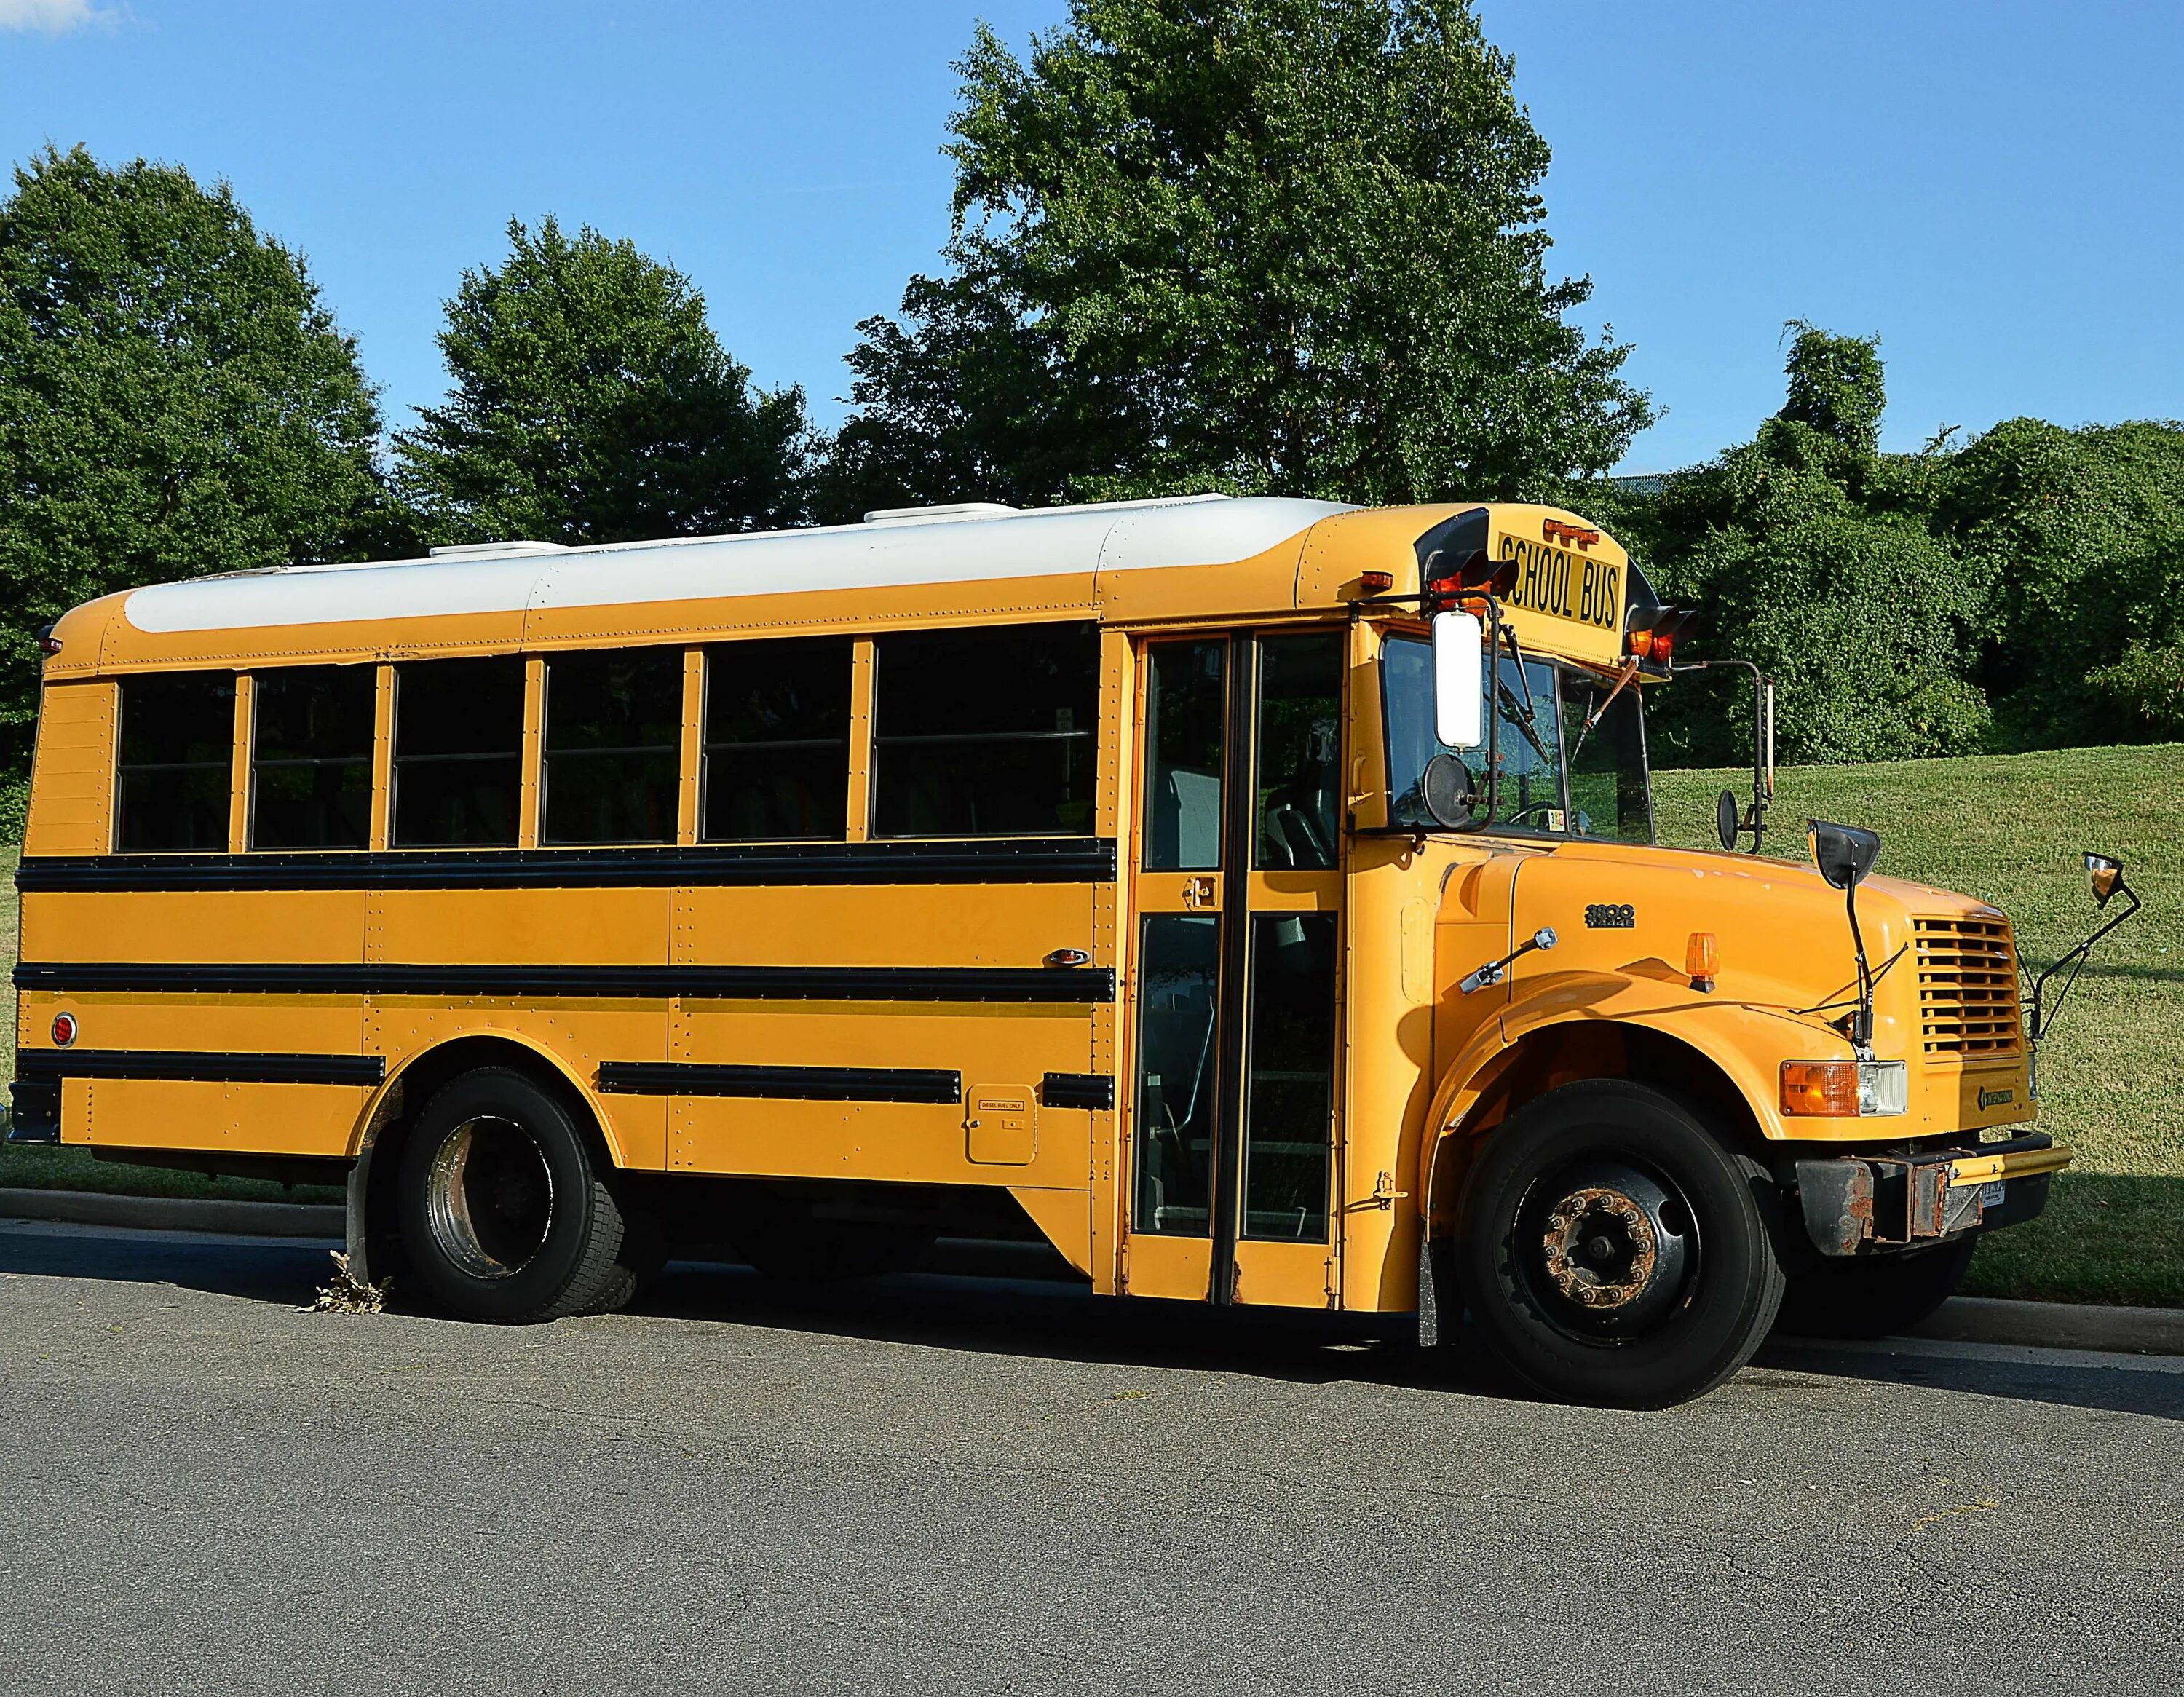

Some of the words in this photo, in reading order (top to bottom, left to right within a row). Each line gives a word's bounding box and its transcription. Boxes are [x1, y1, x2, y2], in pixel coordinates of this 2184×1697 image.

[1500, 537, 1572, 617] SCHOOL
[1580, 561, 1617, 628] BUS
[1585, 903, 1634, 920] 3800
